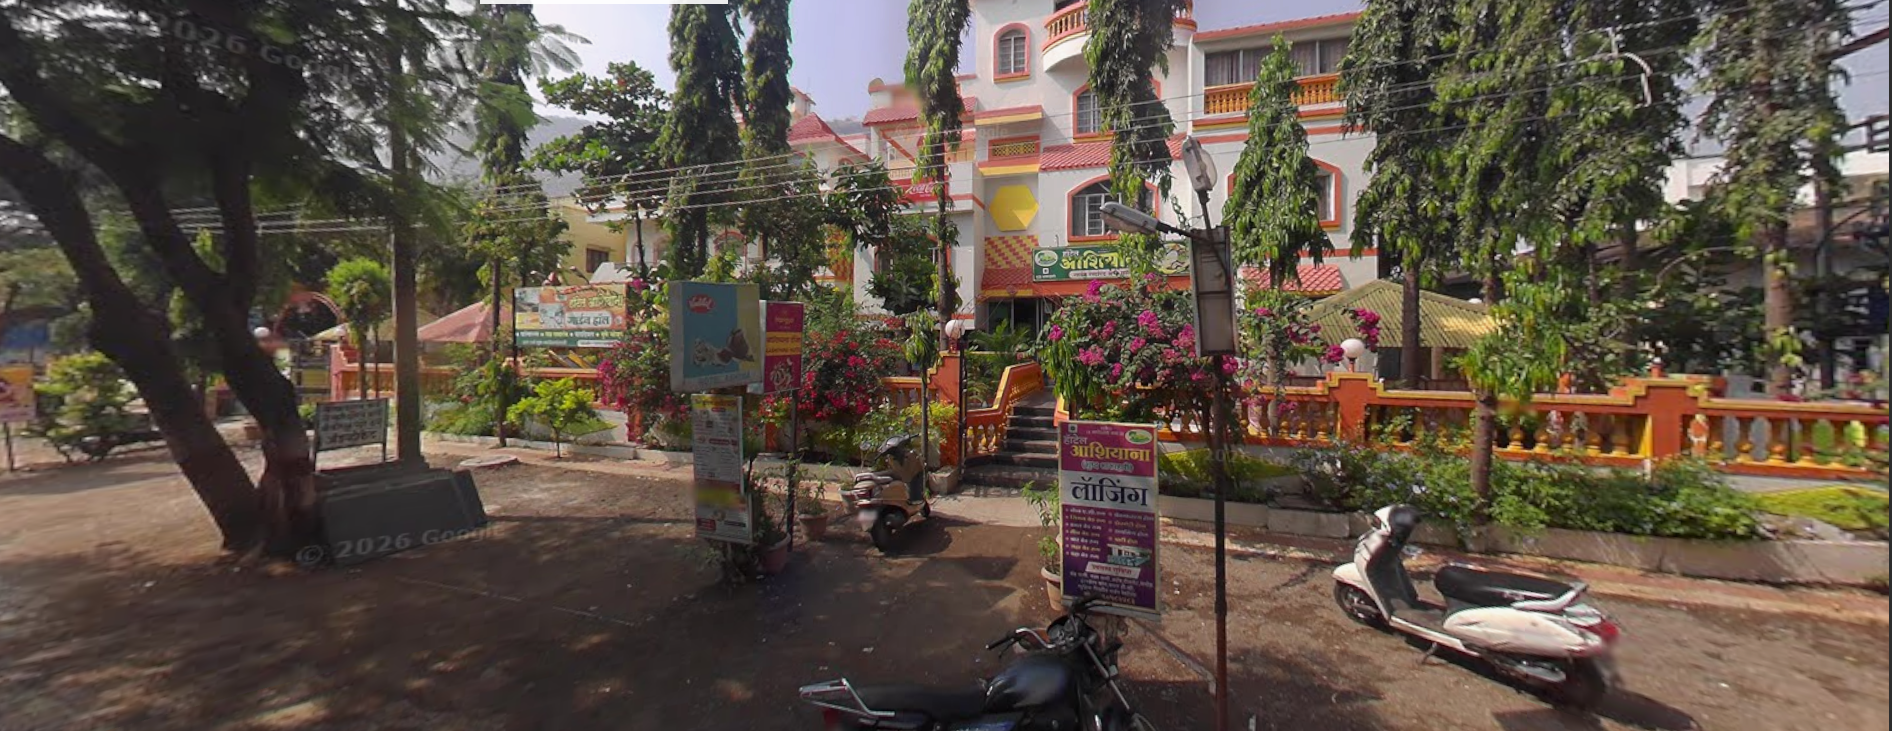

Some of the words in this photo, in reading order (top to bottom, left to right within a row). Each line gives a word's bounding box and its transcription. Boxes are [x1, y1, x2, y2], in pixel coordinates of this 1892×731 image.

[1063, 433, 1088, 445] हॉटेल
[1070, 442, 1151, 462] आशियाना
[1071, 476, 1149, 506] लॉजिंग
